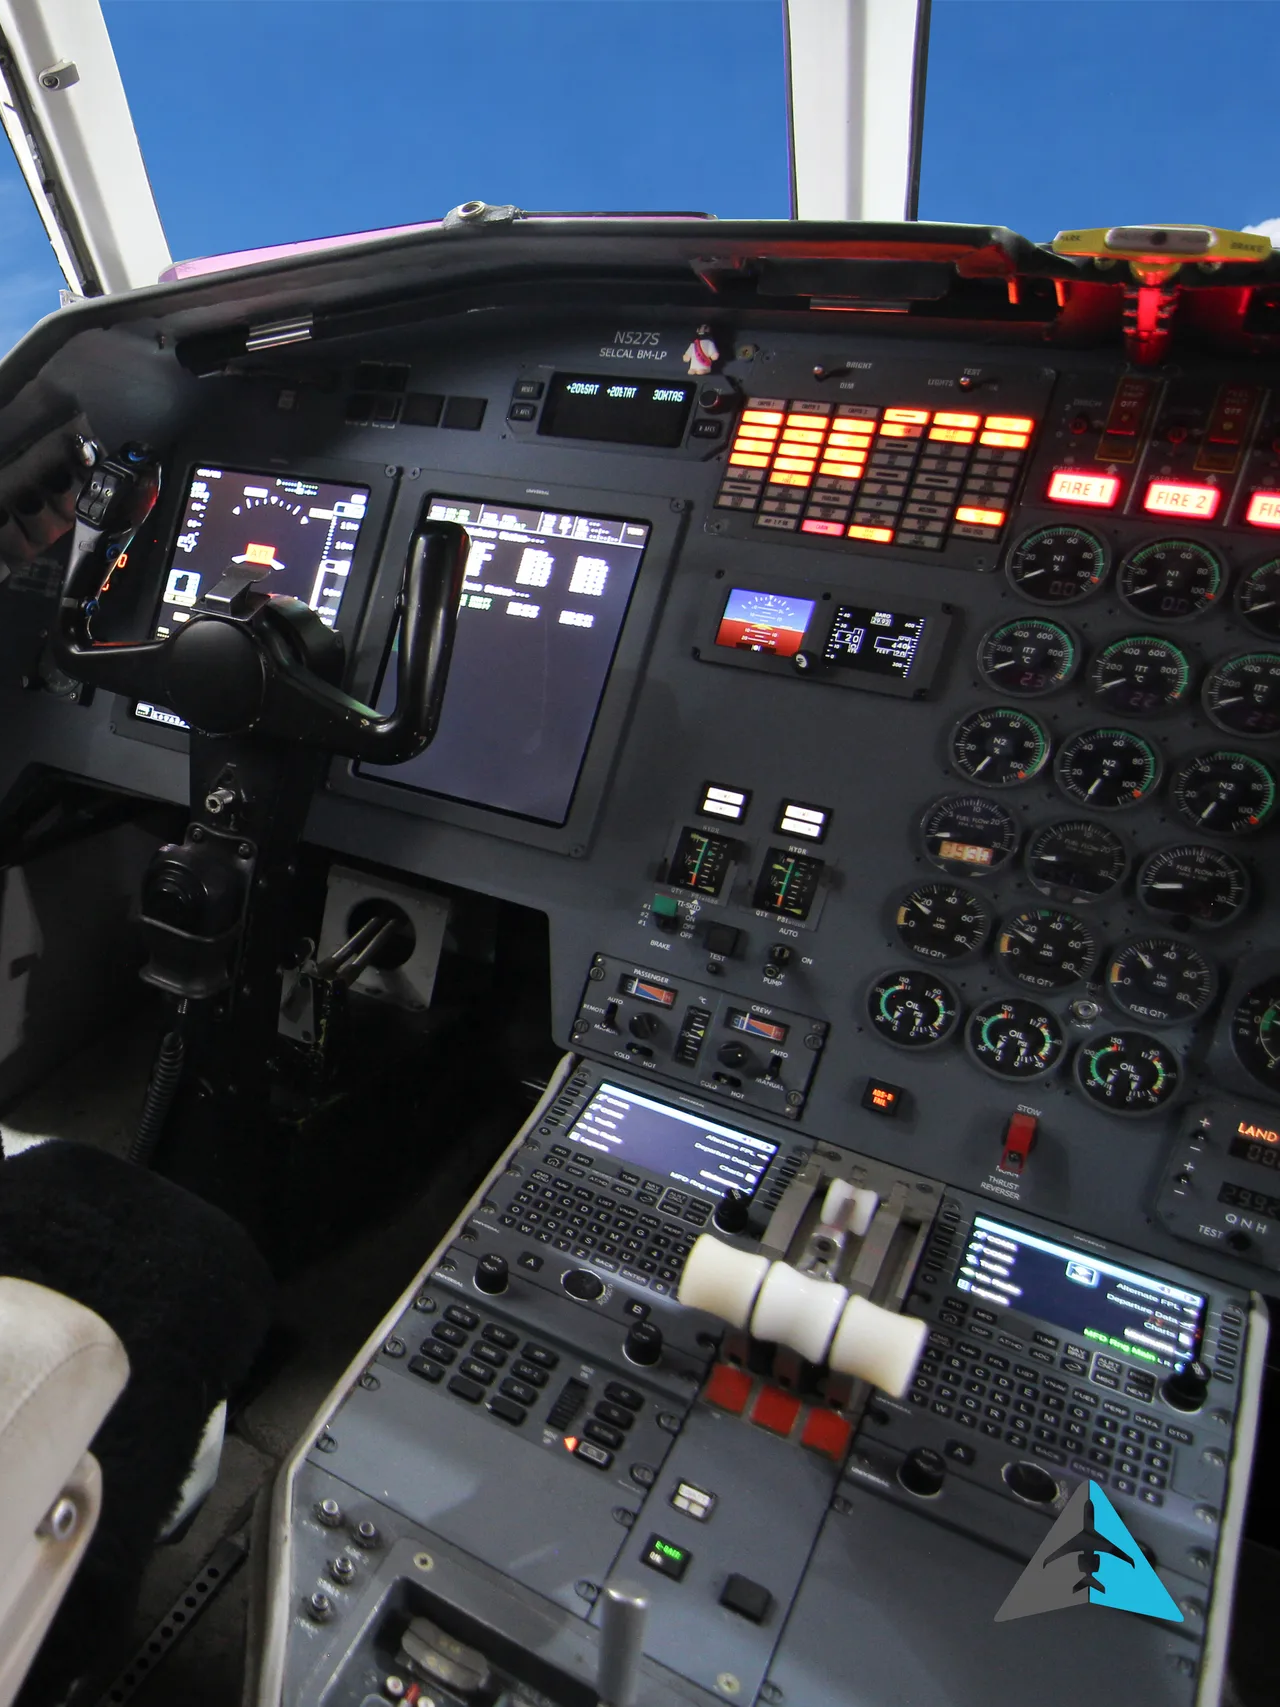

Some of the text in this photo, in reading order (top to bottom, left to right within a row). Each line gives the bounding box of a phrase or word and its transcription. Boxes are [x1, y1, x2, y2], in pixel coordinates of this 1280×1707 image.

[1230, 243, 1264, 253] BRAKE
[614, 331, 660, 345] N527S
[599, 348, 667, 359] SELCAL BM-LP
[846, 361, 872, 369] BRIGHT
[964, 368, 982, 376] TEST
[1059, 481, 1105, 497] FIRE 1
[1156, 492, 1207, 509] FIRE 2
[1037, 632, 1053, 640] 600
[996, 645, 1012, 653] 200
[1023, 646, 1036, 654] ITT
[1105, 663, 1122, 671] 200
[1135, 665, 1148, 673] ITT
[1160, 667, 1177, 675] 800
[1243, 665, 1260, 673] 400
[993, 737, 1007, 745] N2
[1010, 761, 1023, 769] 100
[1102, 759, 1116, 768] N2
[1219, 782, 1234, 790] N2
[702, 825, 720, 833] HYDR
[789, 845, 807, 854] HYDR
[921, 898, 932, 906] 20
[756, 910, 768, 918] QTY
[1025, 925, 1037, 933] 20
[1050, 922, 1062, 930] 40
[680, 931, 693, 939] OFF
[779, 927, 798, 938] AUTO
[954, 934, 966, 943] 80
[650, 940, 671, 950] BRAKE
[1068, 941, 1081, 949] 60
[710, 952, 726, 962] TEST
[913, 945, 947, 960] FUEL QTY
[1163, 952, 1176, 960] 40
[801, 957, 813, 965] ON
[1062, 962, 1074, 970] 80
[633, 968, 669, 984] PASSENGER
[1183, 971, 1197, 979] 60
[763, 976, 783, 986] PUMP
[1019, 974, 1055, 988] FUEL QTY
[607, 996, 623, 1005] AUTO
[1176, 992, 1190, 1001] 80
[583, 1003, 606, 1015] REMOTE
[751, 1005, 772, 1015] CREW
[906, 1001, 920, 1011] OIL
[1130, 1004, 1168, 1019] FUEL QTY
[1009, 1030, 1024, 1040] OIL
[614, 1051, 630, 1060] COLD
[770, 1049, 788, 1058] AUTO
[643, 1061, 656, 1069] HOT
[1120, 1062, 1135, 1072] OIL
[700, 1081, 717, 1090] COLD
[755, 1078, 784, 1091] MANUAL
[731, 1091, 745, 1099] HOT
[872, 1089, 895, 1101] ADS-B
[873, 1097, 887, 1107] FAIL
[1017, 1104, 1042, 1116] STOW
[1238, 1122, 1278, 1143] LAND
[705, 1134, 756, 1157] Alternate FPL
[694, 1142, 750, 1166] Departure Data
[719, 1164, 745, 1178] Charts
[622, 1175, 637, 1183] TUNE
[988, 1175, 1019, 1190] THRUST
[981, 1182, 1019, 1200] REVERSER
[599, 1199, 612, 1207] LIST
[620, 1208, 636, 1216] VNAV
[642, 1217, 657, 1226] FUEL
[686, 1214, 702, 1222] NEXT
[664, 1225, 681, 1234] PERF
[1198, 1224, 1224, 1239] TEST
[595, 1258, 614, 1269] BACK
[435, 1271, 463, 1288] UNIVERSAL
[623, 1270, 646, 1282] ENTER
[1116, 1282, 1181, 1311] Alternate FPL
[1106, 1293, 1179, 1324] Departure Data
[976, 1311, 993, 1320] MFD
[971, 1326, 988, 1335] DISP
[1143, 1322, 1176, 1338] Charts
[1036, 1335, 1056, 1346] TUNE
[1084, 1328, 1108, 1344] MFD
[1110, 1338, 1130, 1353] Rng
[1132, 1347, 1157, 1363] Main
[1032, 1351, 1050, 1361] ADC
[1099, 1357, 1121, 1368] ALRT
[1016, 1369, 1034, 1377] LIST
[1044, 1378, 1067, 1391] VNAV
[1095, 1374, 1115, 1386] MSG
[1074, 1390, 1096, 1404] FUEL
[1126, 1386, 1149, 1399] NEXT
[1104, 1403, 1127, 1416] PERF
[1135, 1415, 1159, 1429] DATA
[1168, 1428, 1188, 1439] DTO
[1035, 1446, 1060, 1459] BACK
[1073, 1462, 1104, 1479] ENTER
